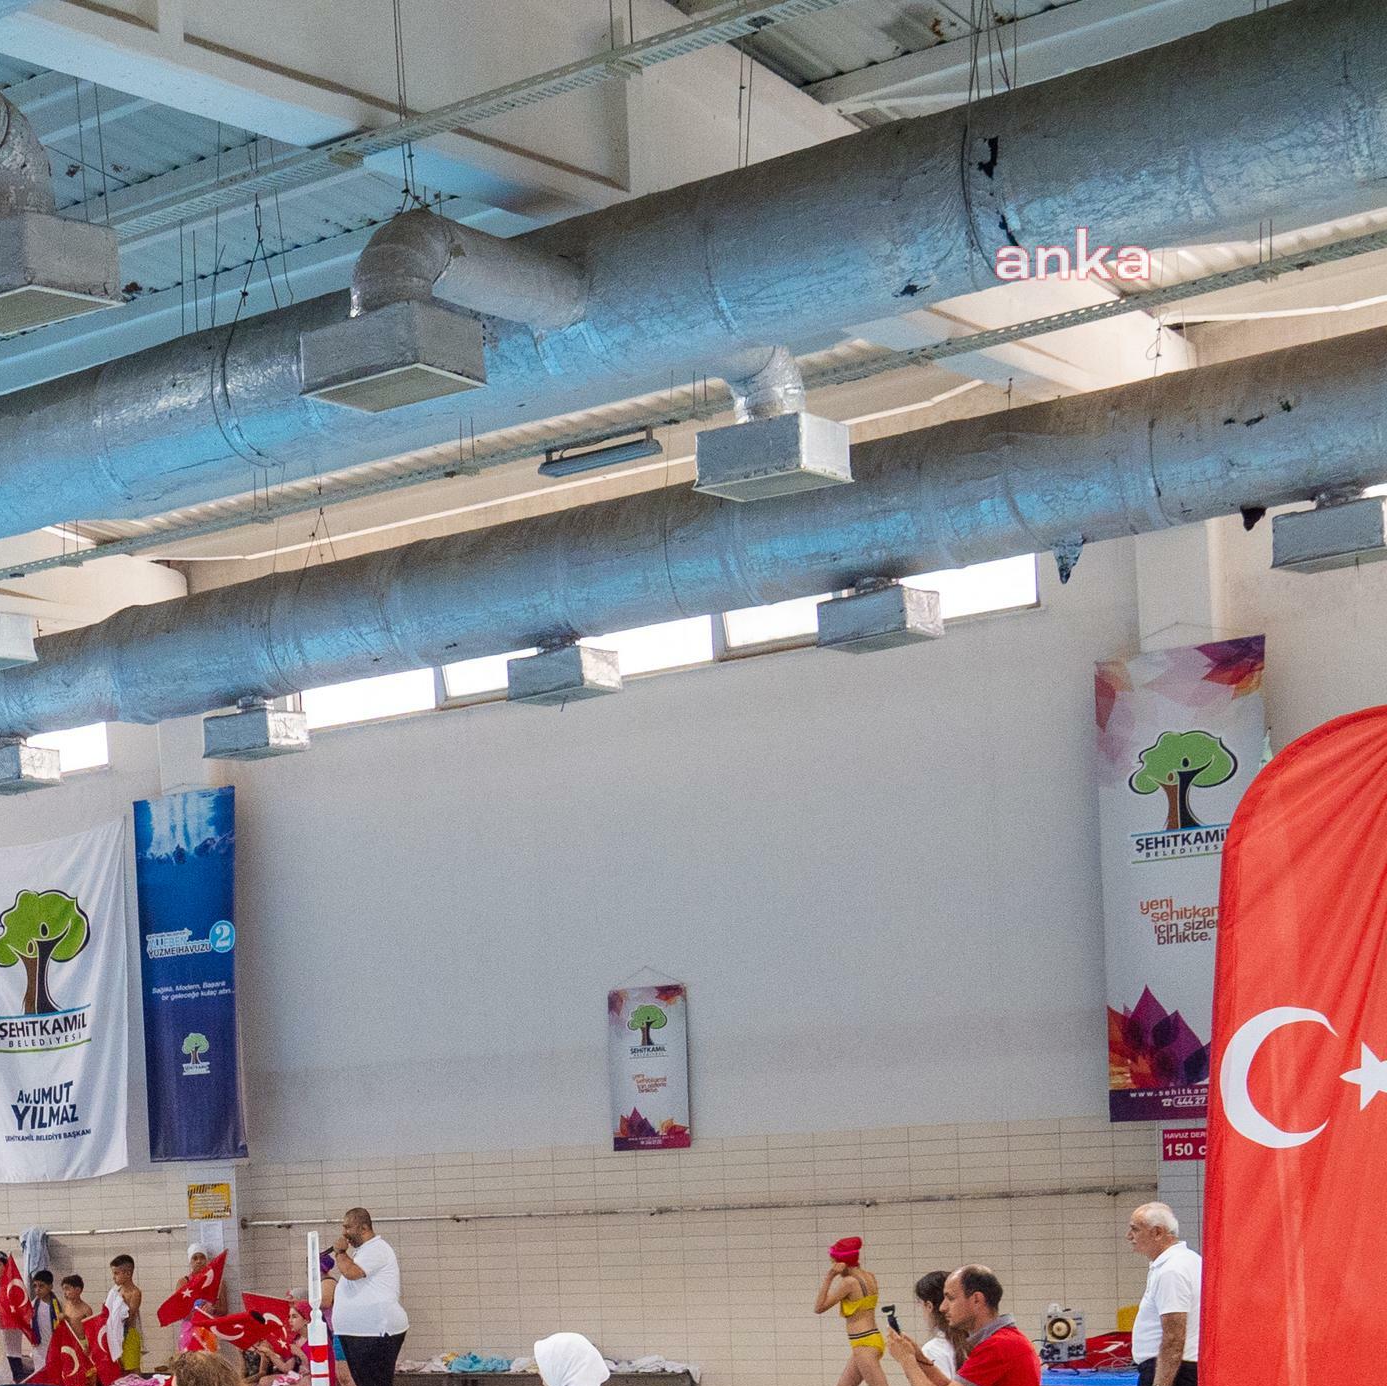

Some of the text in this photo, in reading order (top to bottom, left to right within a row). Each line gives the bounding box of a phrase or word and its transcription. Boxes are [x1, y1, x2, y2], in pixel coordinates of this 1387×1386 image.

[214, 924, 232, 949] 2
[10, 1103, 79, 1131] YILMAZ
[1165, 1143, 1207, 1156] 150 c
